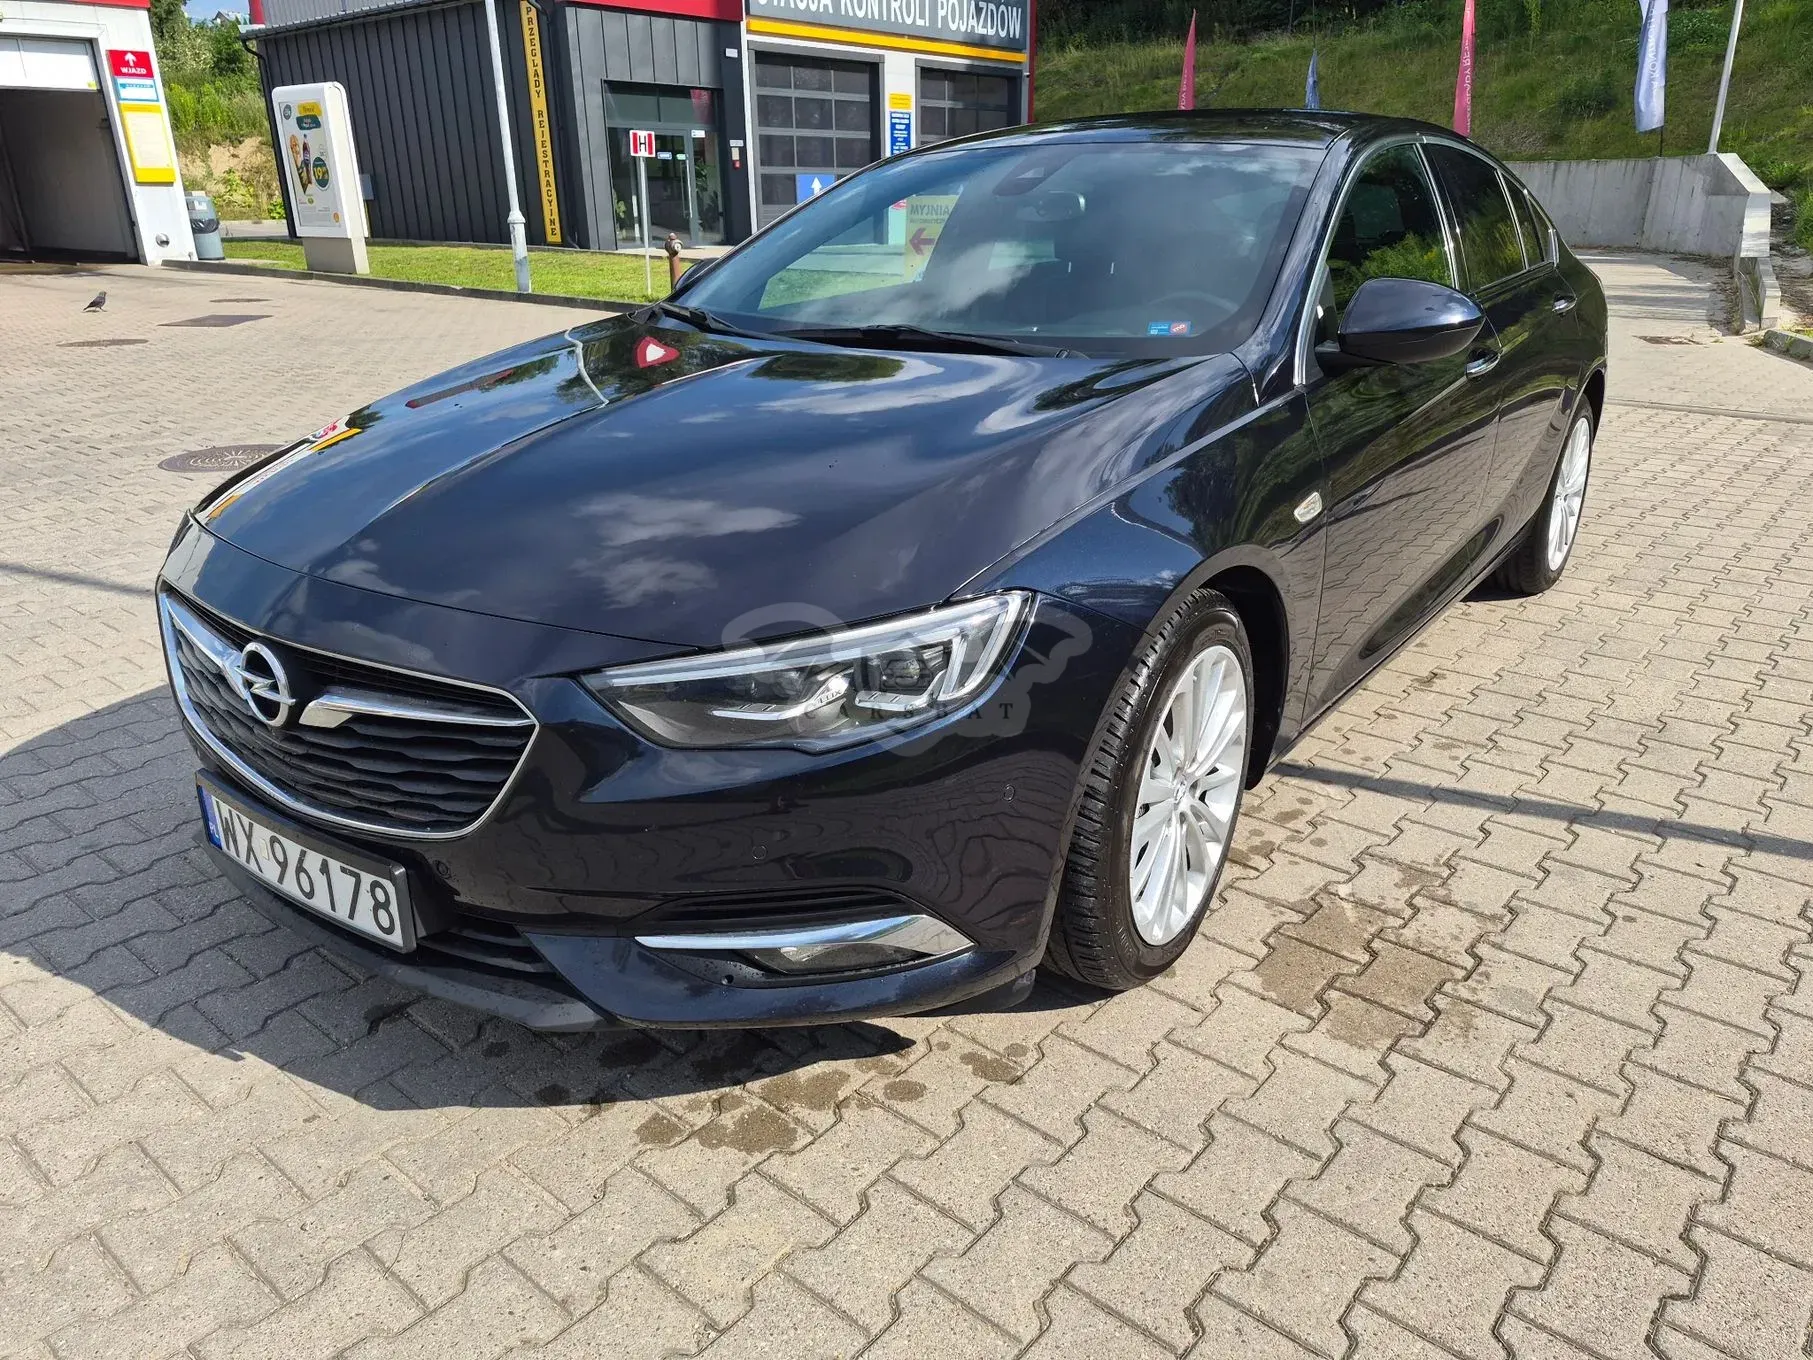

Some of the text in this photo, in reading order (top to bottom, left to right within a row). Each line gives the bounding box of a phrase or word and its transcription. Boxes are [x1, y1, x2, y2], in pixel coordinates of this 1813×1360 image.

[120, 66, 147, 75] WJAZD
[639, 135, 647, 153] H
[910, 204, 950, 216] MYJNIA
[216, 800, 396, 936] WX 96178
